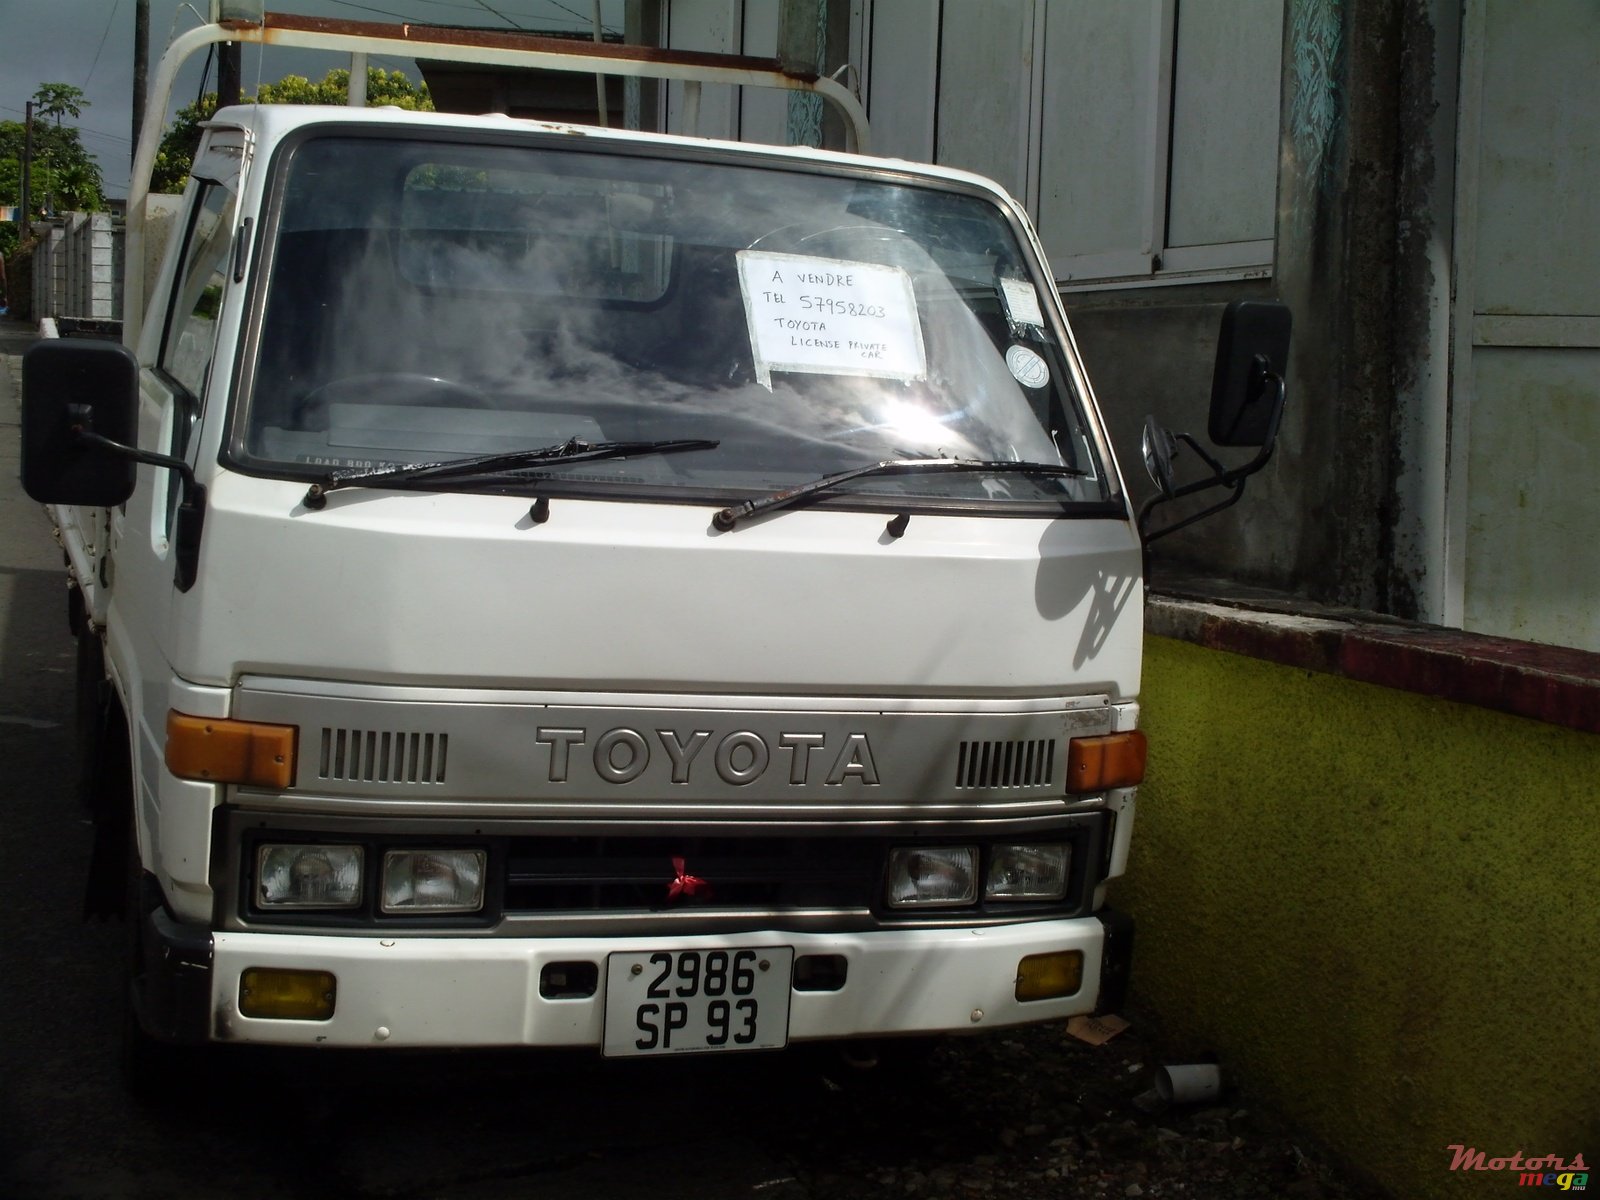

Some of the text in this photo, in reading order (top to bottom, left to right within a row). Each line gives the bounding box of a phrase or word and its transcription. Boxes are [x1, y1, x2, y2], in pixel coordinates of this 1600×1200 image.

[772, 270, 854, 286] A VENDRE
[763, 291, 886, 318] TEL 57958203
[774, 317, 827, 331] TOYOTA
[791, 335, 888, 352] LICENSE PRIVATE
[860, 350, 884, 359] CAR
[535, 726, 881, 786] TOYOTA
[647, 950, 757, 998] 2986
[635, 998, 758, 1050] SP 93
